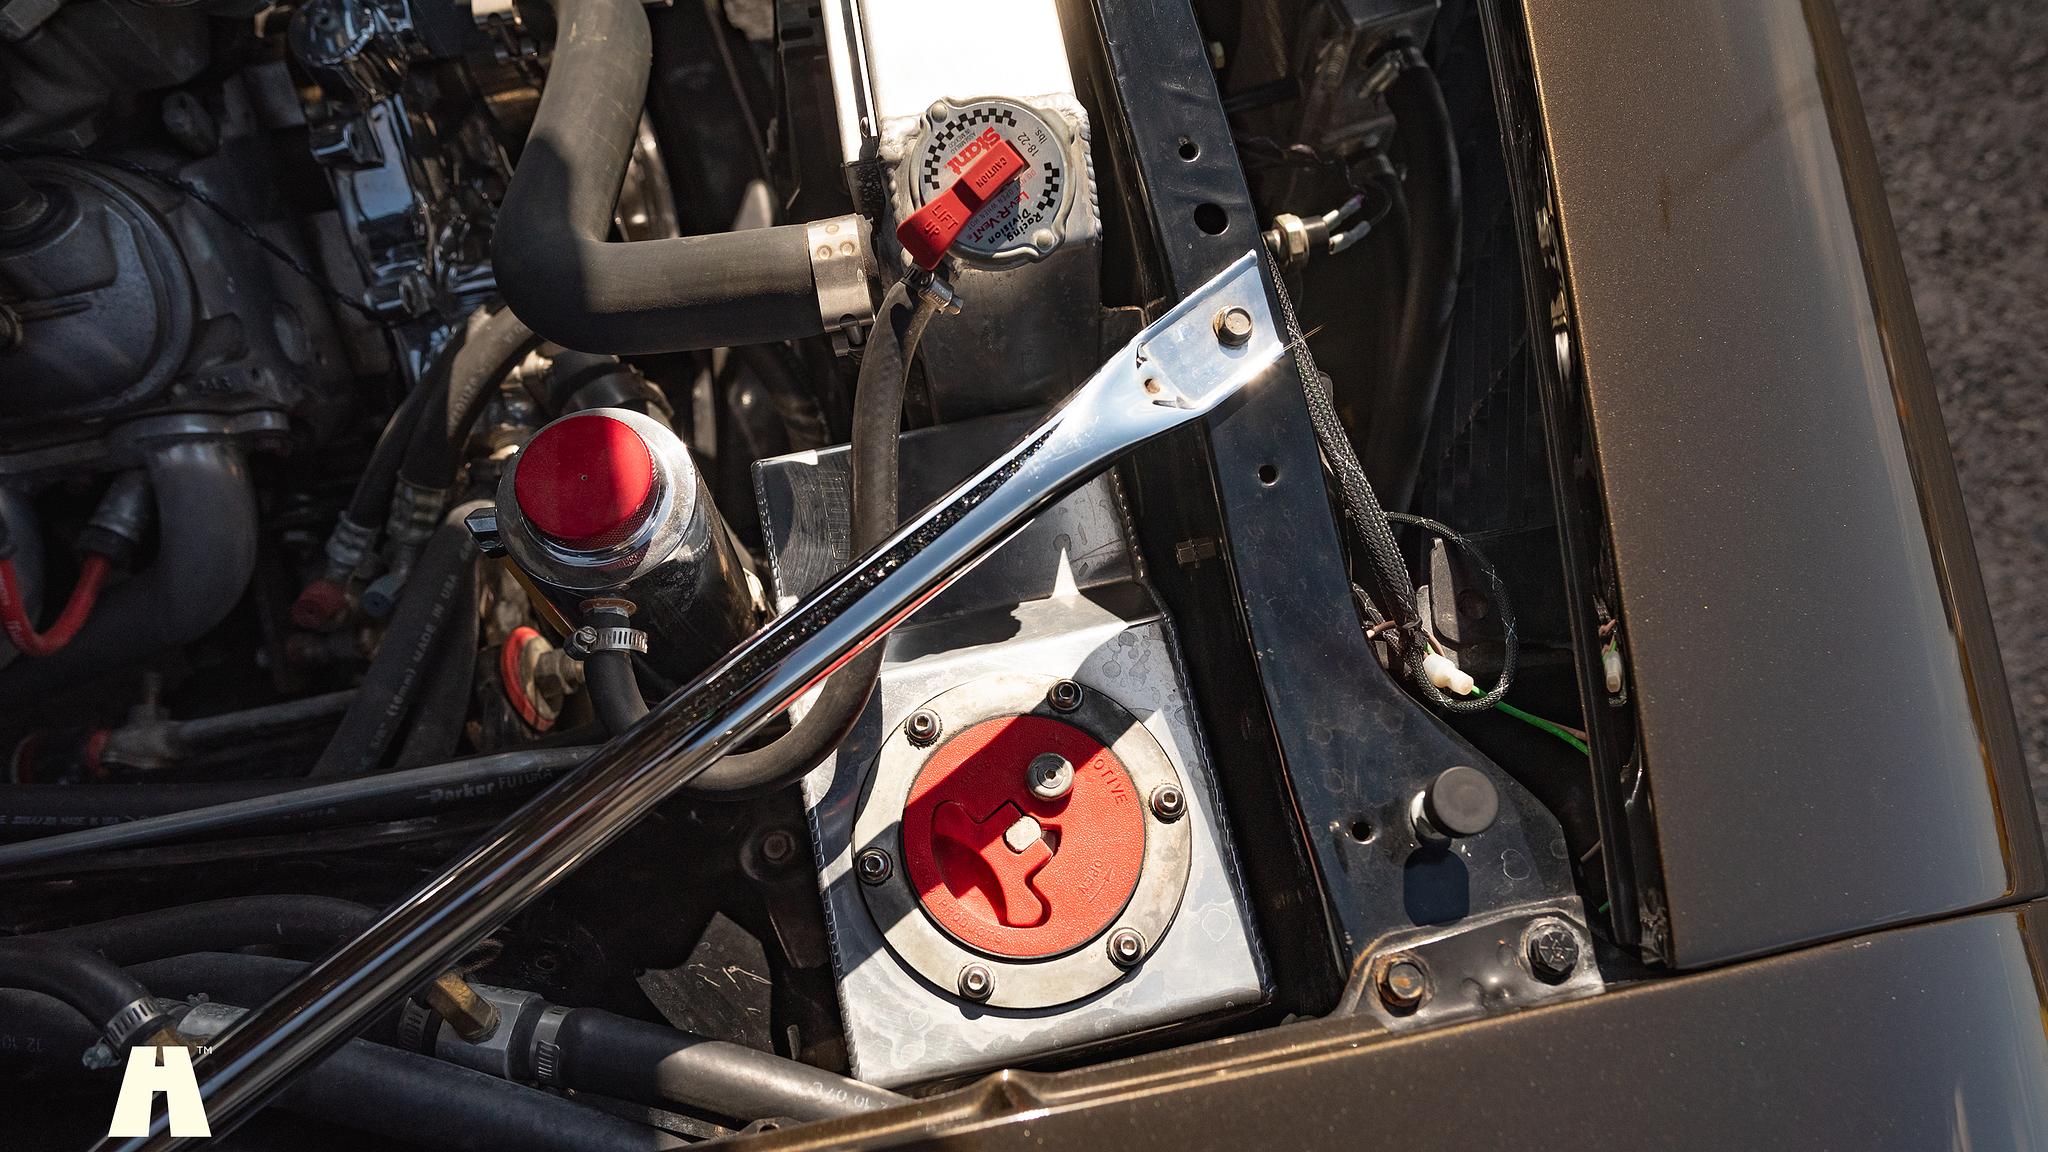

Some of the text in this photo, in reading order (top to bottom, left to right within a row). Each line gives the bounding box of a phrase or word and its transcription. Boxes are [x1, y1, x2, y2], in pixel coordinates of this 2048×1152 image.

[946, 127, 1001, 174] Stant
[1017, 131, 1040, 157] 18-22
[975, 157, 1007, 188] CAUTION
[924, 222, 940, 236] UP
[932, 204, 958, 230] LIFT
[987, 208, 1030, 244] Division
[1005, 212, 1042, 242] Racing
